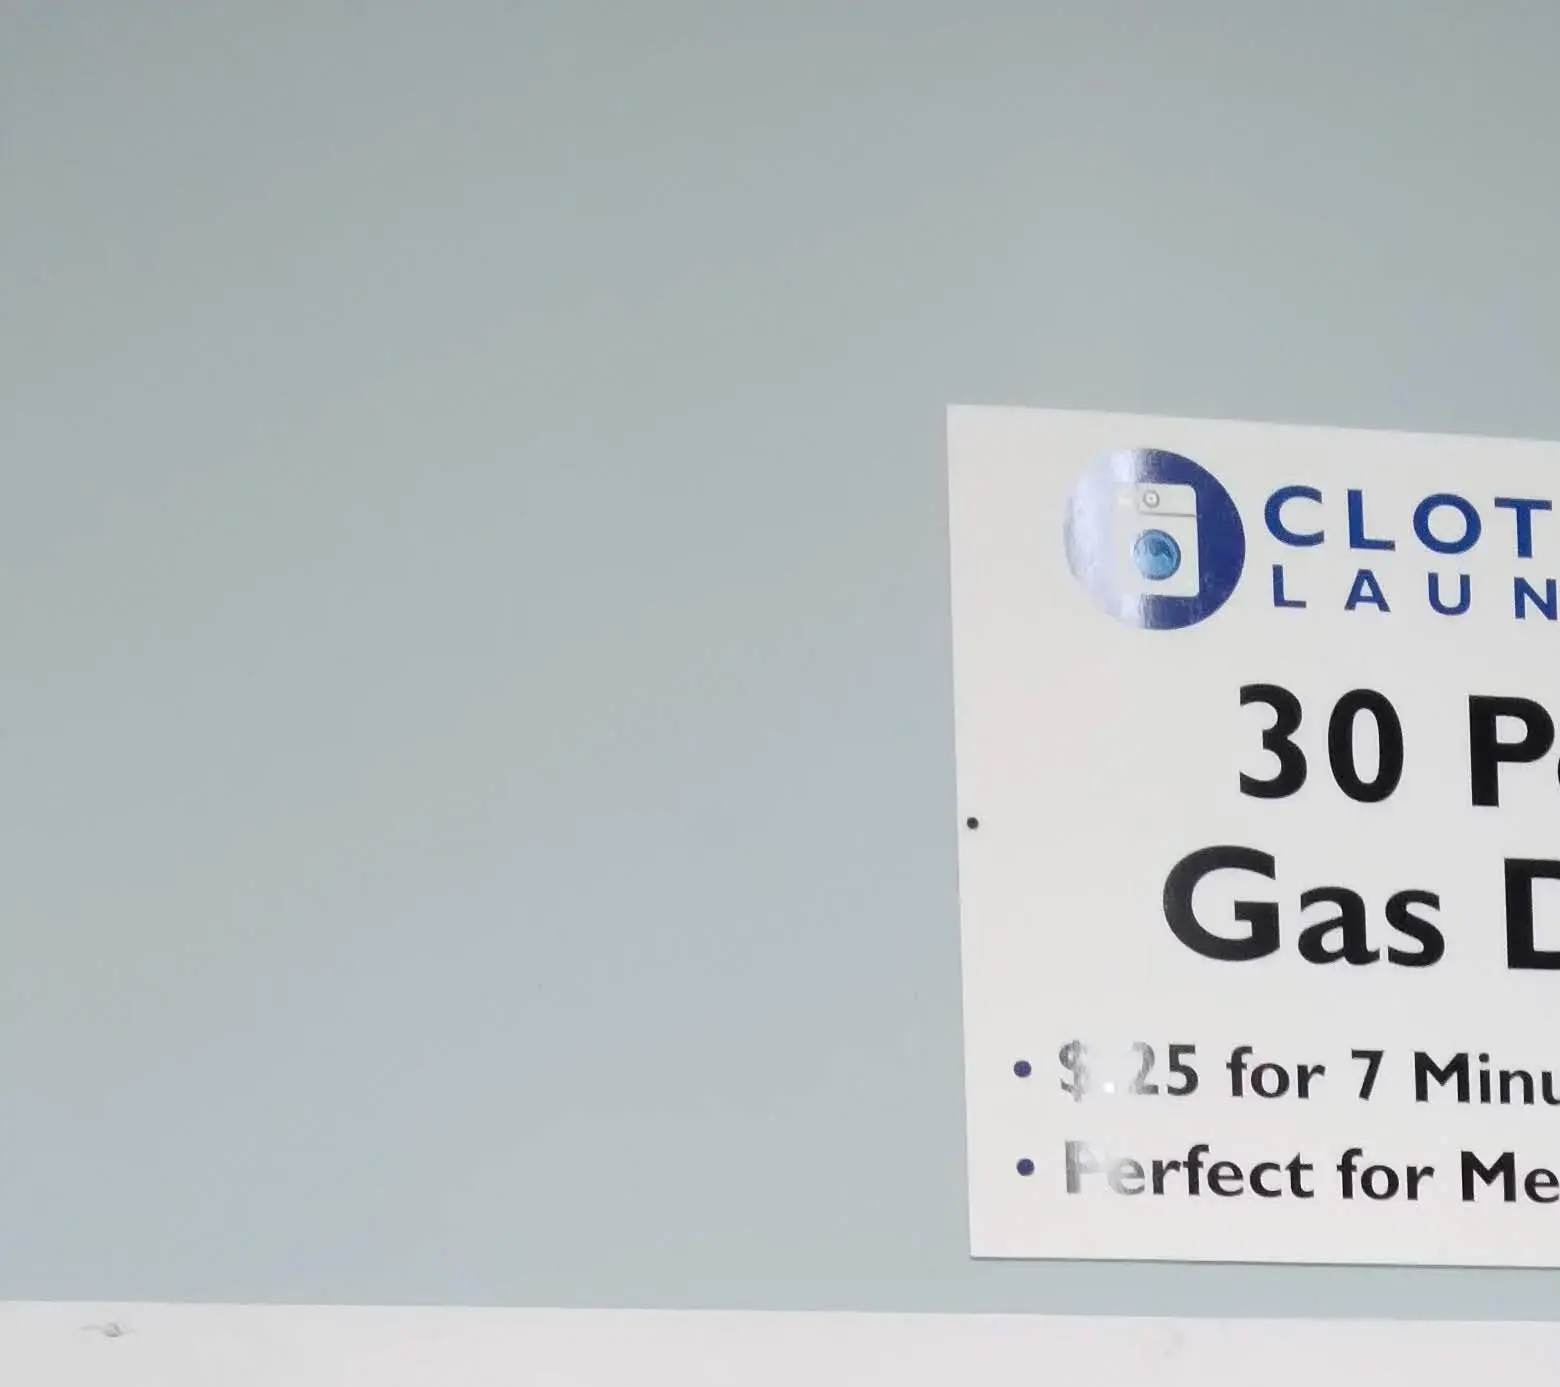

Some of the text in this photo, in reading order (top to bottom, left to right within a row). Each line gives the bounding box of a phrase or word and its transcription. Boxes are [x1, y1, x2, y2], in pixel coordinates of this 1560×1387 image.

[1239, 683, 1404, 804] 30
[1162, 845, 1445, 968] Gas
[1225, 1045, 1326, 1100] for
[1350, 1048, 1385, 1101] 7
[1064, 1140, 1315, 1200] Perfect
[1336, 1147, 1436, 1201] for
